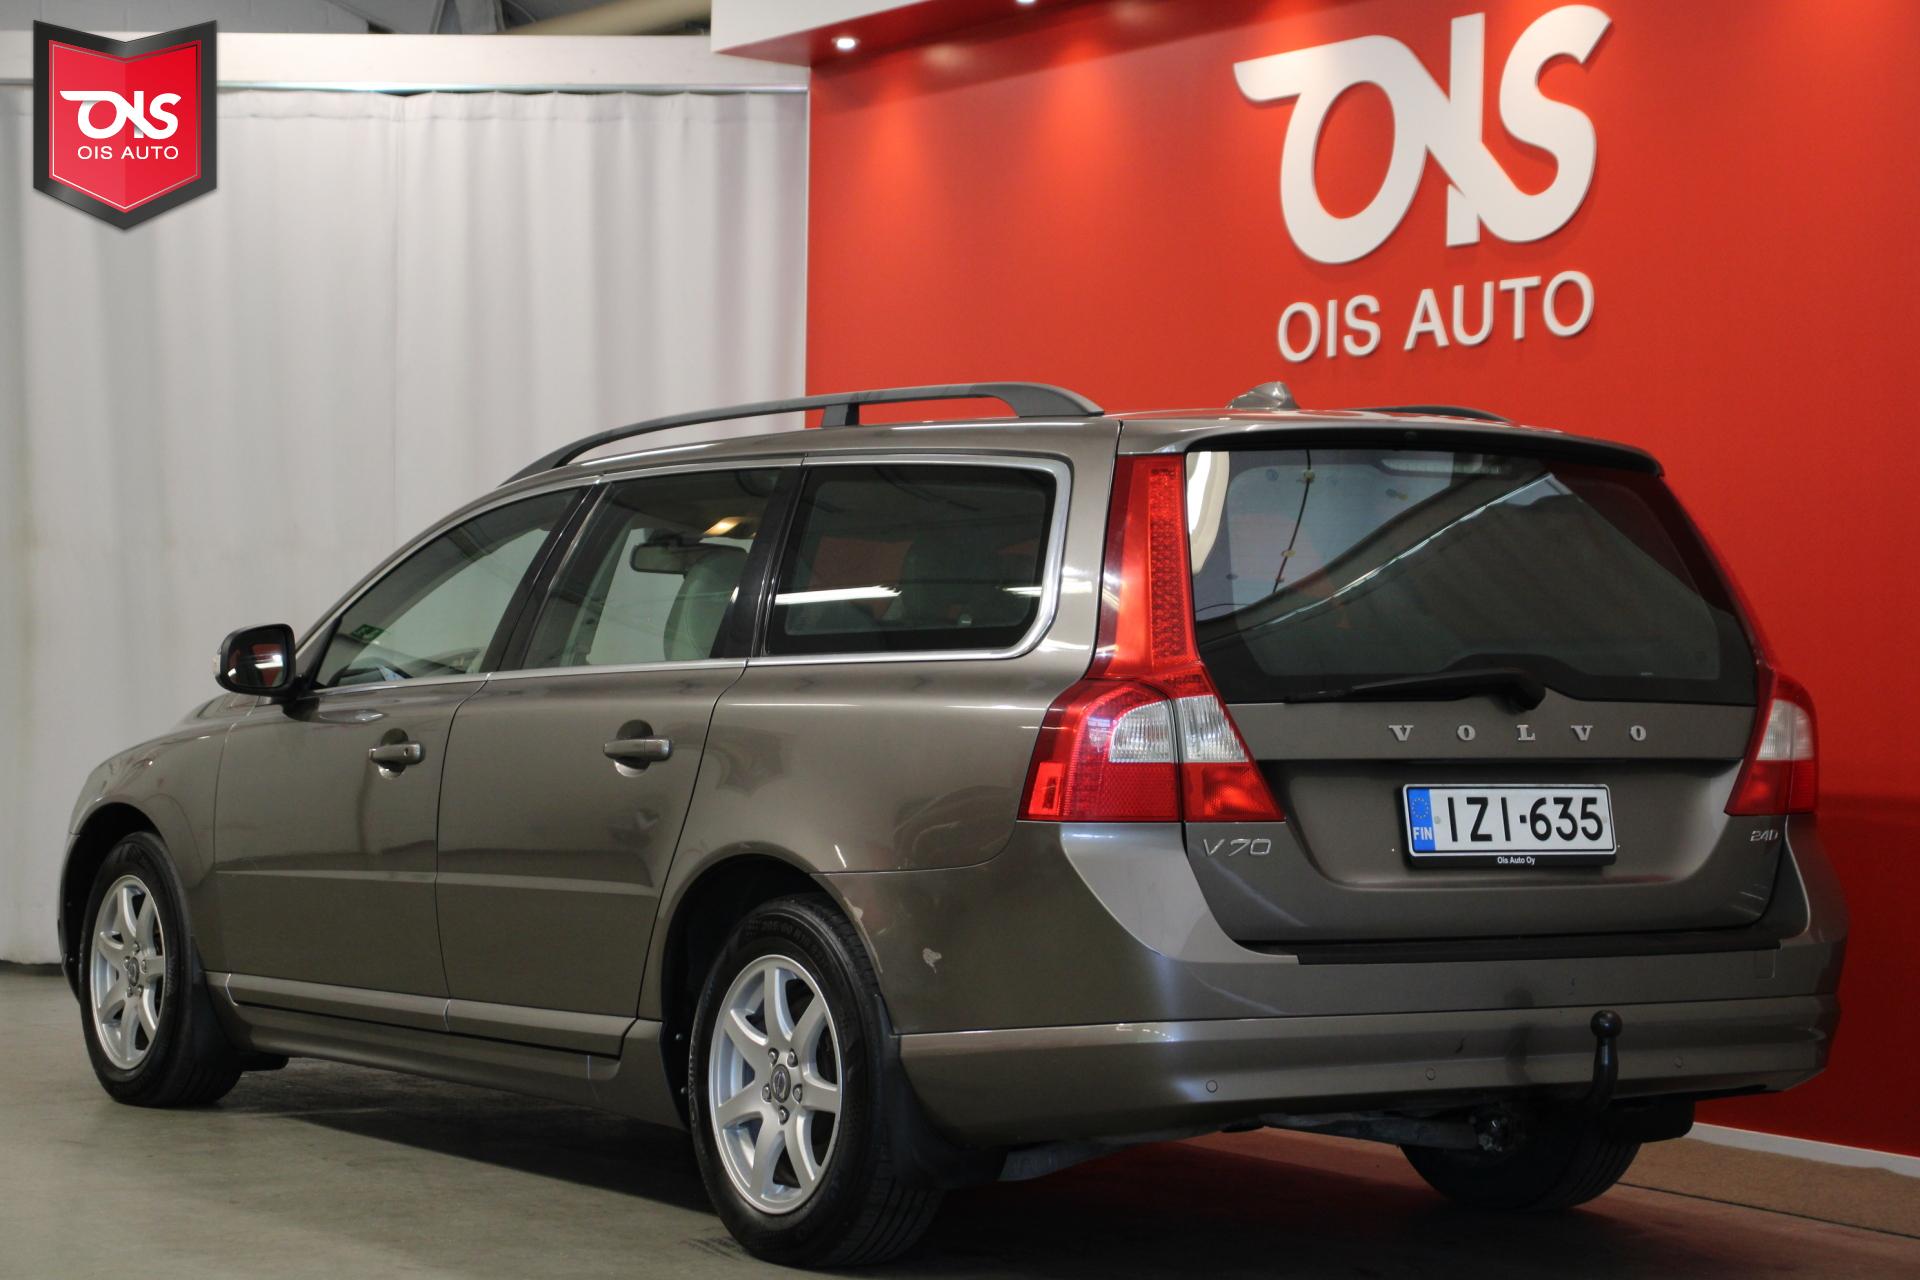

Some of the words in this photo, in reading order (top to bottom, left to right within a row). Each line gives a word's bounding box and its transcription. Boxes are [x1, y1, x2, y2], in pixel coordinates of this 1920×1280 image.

[1277, 295, 1381, 363] OIS
[1404, 270, 1595, 351] AUTO
[1388, 724, 1648, 742] VOLVO
[1412, 826, 1433, 841] FIN
[1203, 837, 1272, 857] V70
[1496, 856, 1509, 864] Ois
[1509, 856, 1526, 864] Auto
[1526, 856, 1536, 866] Oy
